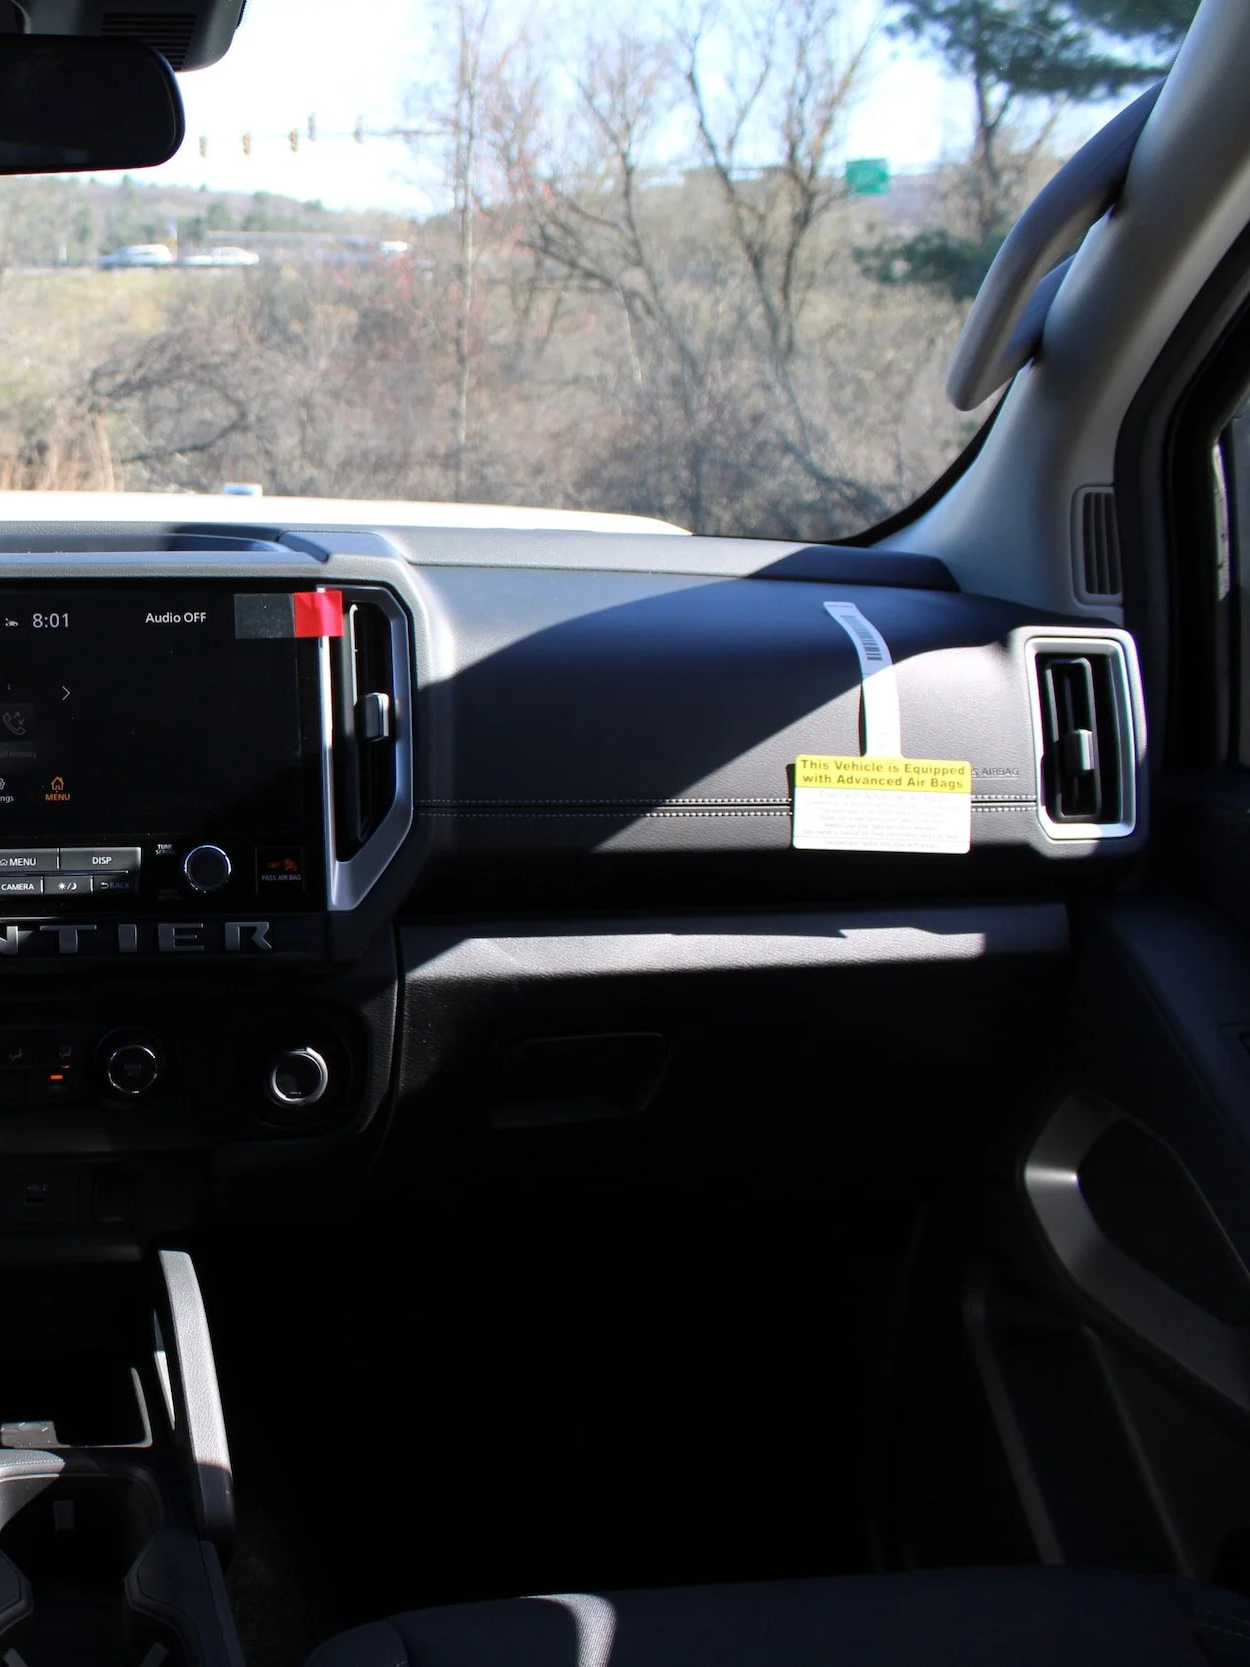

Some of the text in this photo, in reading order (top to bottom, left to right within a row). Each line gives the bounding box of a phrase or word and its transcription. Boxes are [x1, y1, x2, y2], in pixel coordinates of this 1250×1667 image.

[32, 612, 71, 629] 8:01
[145, 611, 207, 624] Audio OFF
[800, 759, 830, 771] This
[834, 760, 884, 774] Vehicle
[888, 762, 900, 773] is
[904, 763, 966, 779] Equipped
[802, 773, 963, 790] with Advanced Air Bags
[45, 792, 71, 801] MENU
[9, 857, 37, 867] MENU
[92, 856, 112, 865] DISP
[1, 882, 35, 891] CAMERA
